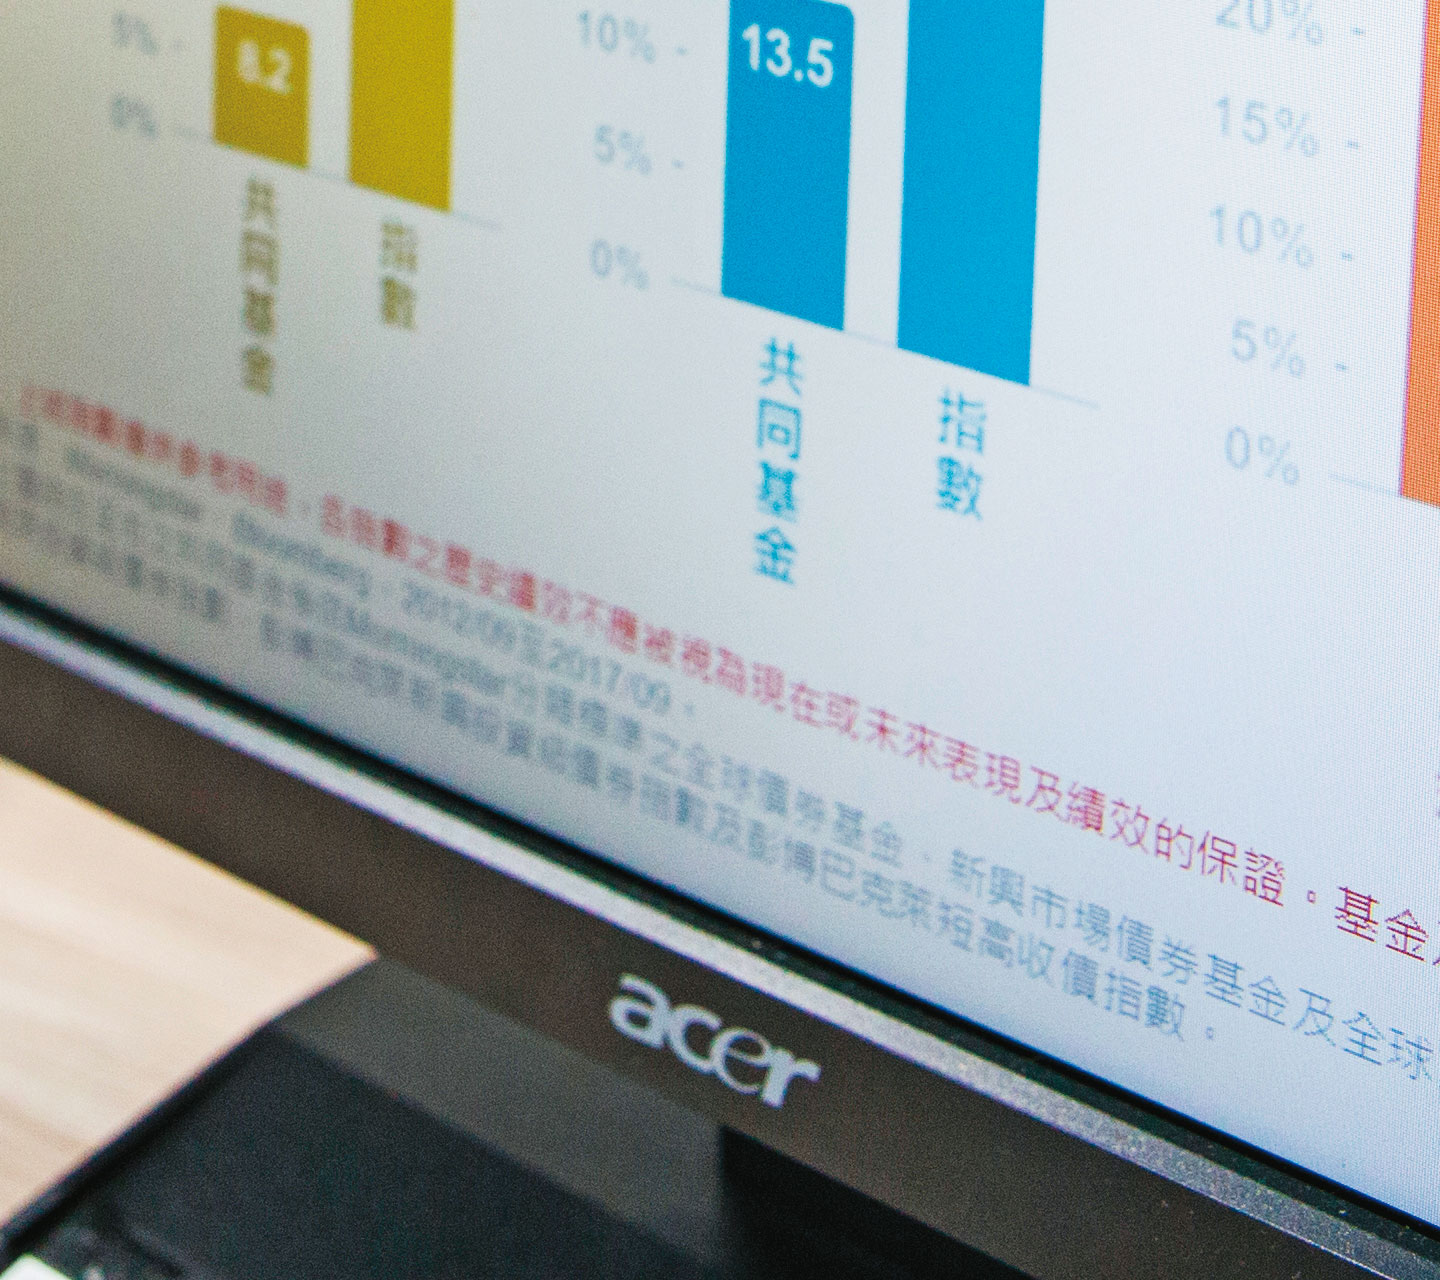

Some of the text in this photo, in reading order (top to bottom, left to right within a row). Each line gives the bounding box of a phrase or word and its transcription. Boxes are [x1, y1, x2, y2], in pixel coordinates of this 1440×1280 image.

[577, 10, 656, 64] 10%
[742, 23, 834, 89] 13.5
[593, 124, 652, 175] 5%
[1213, 96, 1320, 159] 15%
[590, 238, 649, 290] 0%
[1208, 205, 1315, 269] 10%
[1230, 317, 1307, 380] 5%
[754, 335, 805, 586] 共同基金
[936, 385, 987, 522] 指數
[1224, 426, 1302, 487] 0%
[608, 972, 821, 1109] acer
